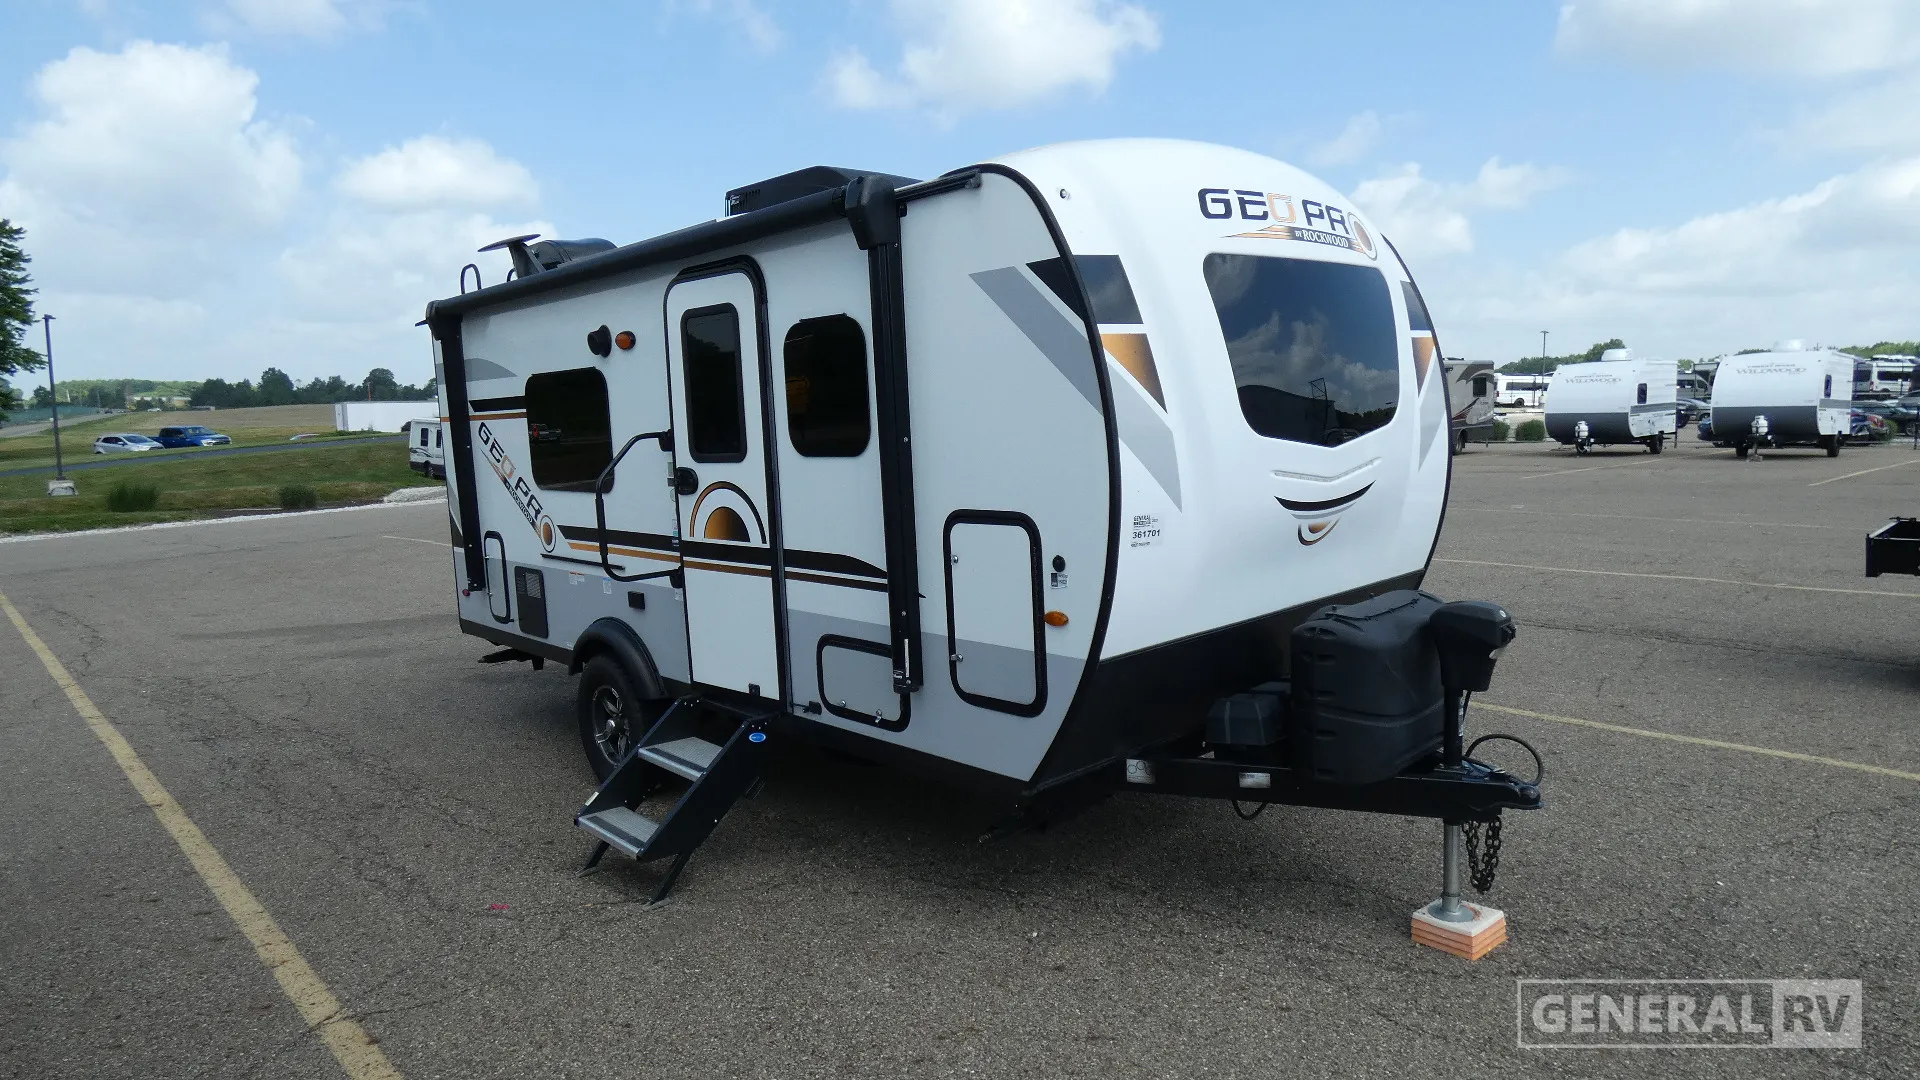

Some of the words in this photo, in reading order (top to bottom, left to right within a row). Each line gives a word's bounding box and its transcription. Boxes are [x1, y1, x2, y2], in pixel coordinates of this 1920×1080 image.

[1197, 187, 1297, 224] GEO
[1302, 229, 1349, 248] ROCKWOOD
[478, 421, 516, 479] GEO
[1132, 529, 1161, 539] 361701
